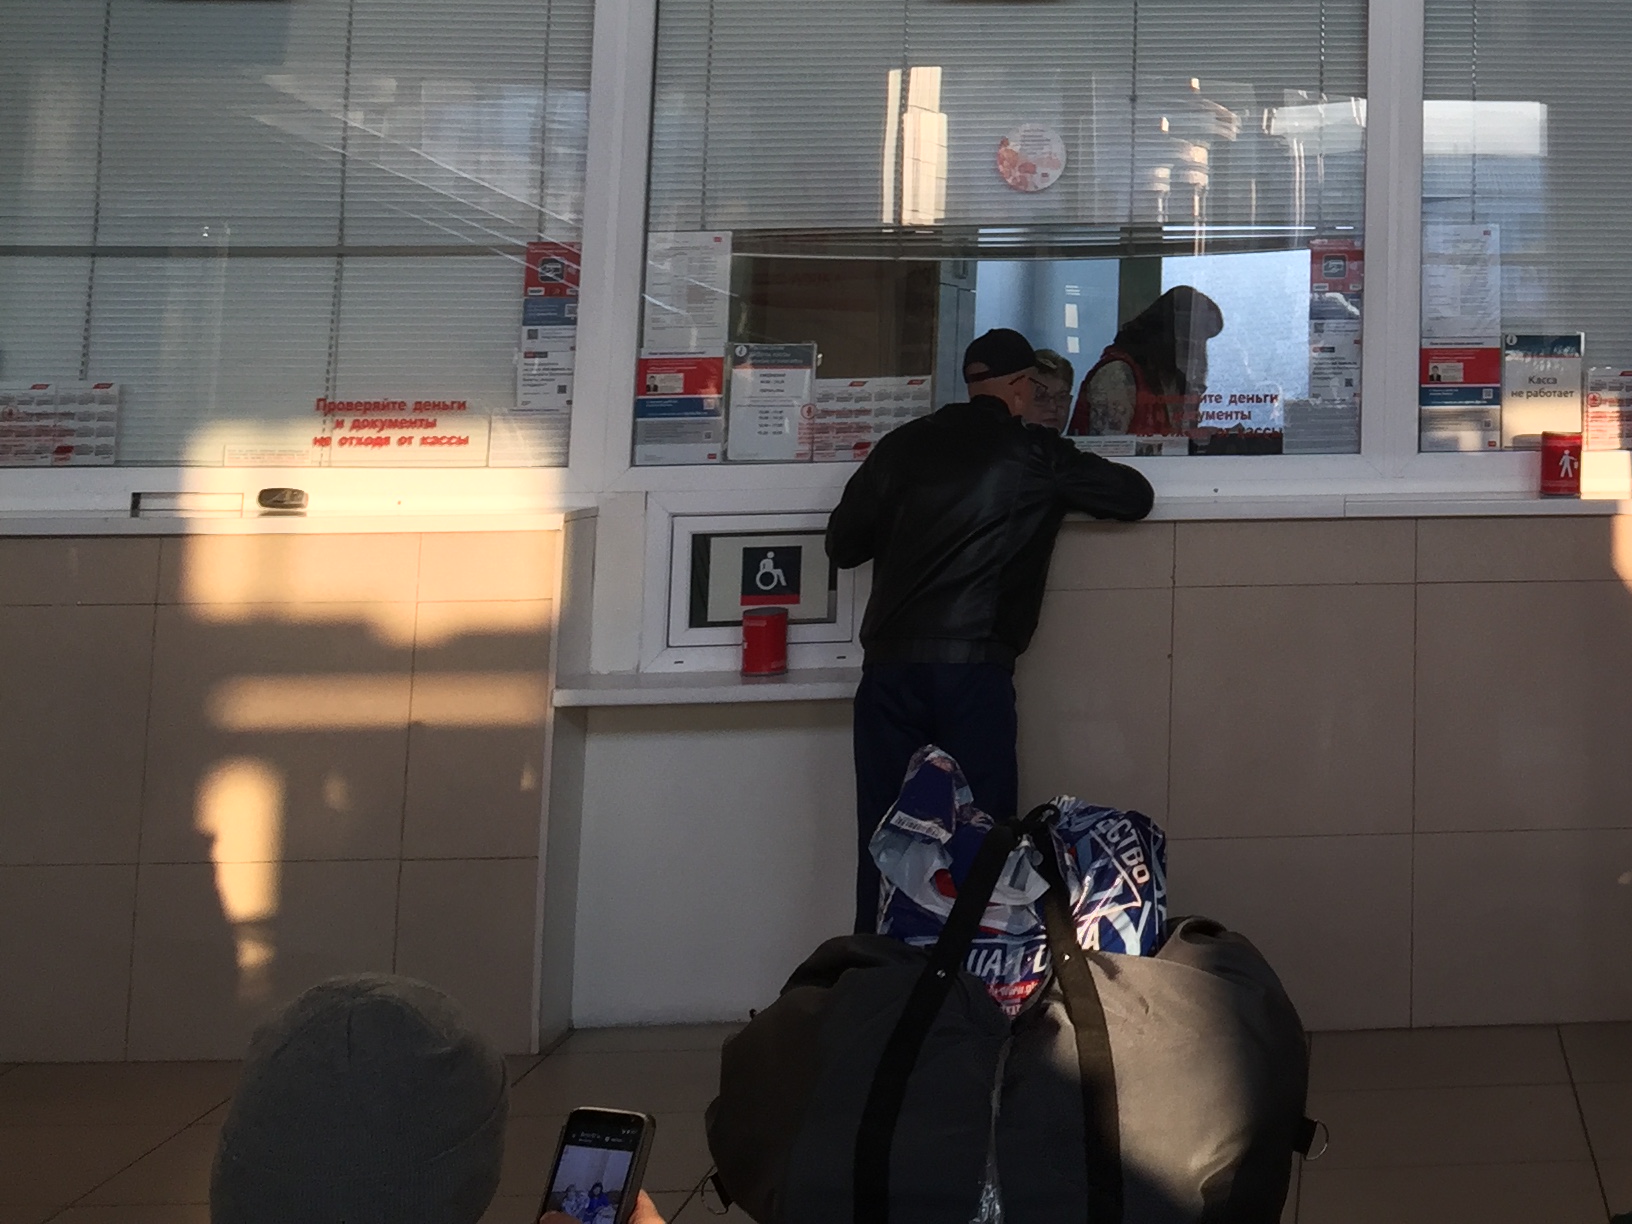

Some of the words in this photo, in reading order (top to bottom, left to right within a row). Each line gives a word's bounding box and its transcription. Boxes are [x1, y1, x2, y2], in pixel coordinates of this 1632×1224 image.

[1528, 375, 1558, 385] Касса
[1228, 393, 1279, 406] деньги
[1511, 389, 1523, 398] не
[1526, 387, 1574, 400] работает
[315, 397, 407, 414] Проверяйте
[413, 400, 467, 413] деньги
[335, 418, 345, 429] и
[350, 418, 437, 433] документы
